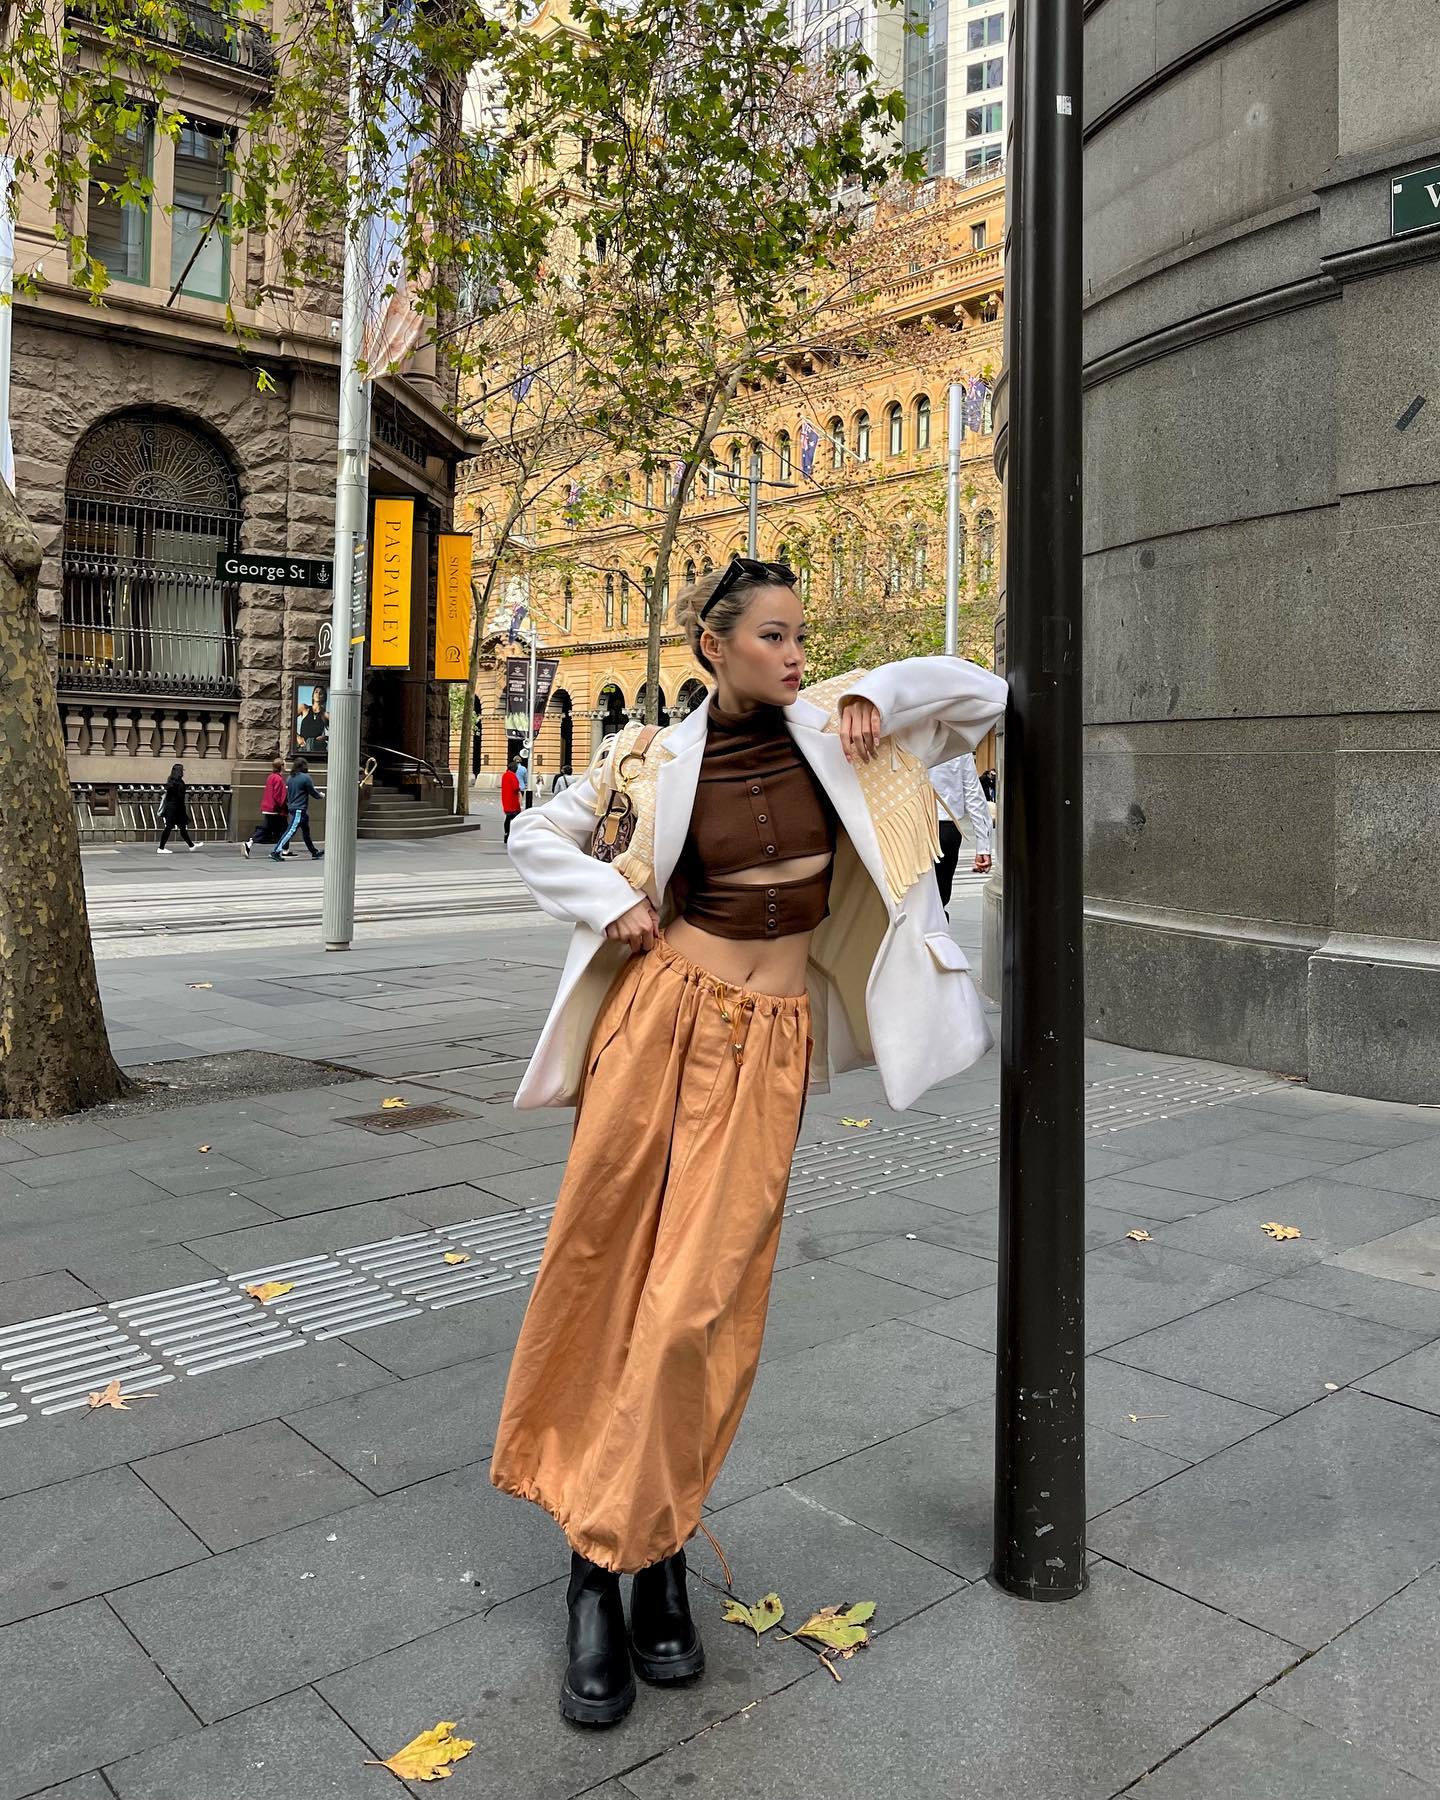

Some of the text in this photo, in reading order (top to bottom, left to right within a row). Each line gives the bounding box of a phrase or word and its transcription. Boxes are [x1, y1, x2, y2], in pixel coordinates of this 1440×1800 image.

[225, 559, 306, 581] George St
[382, 521, 401, 647] PASPALEY
[448, 556, 459, 619] SINCE 1935
